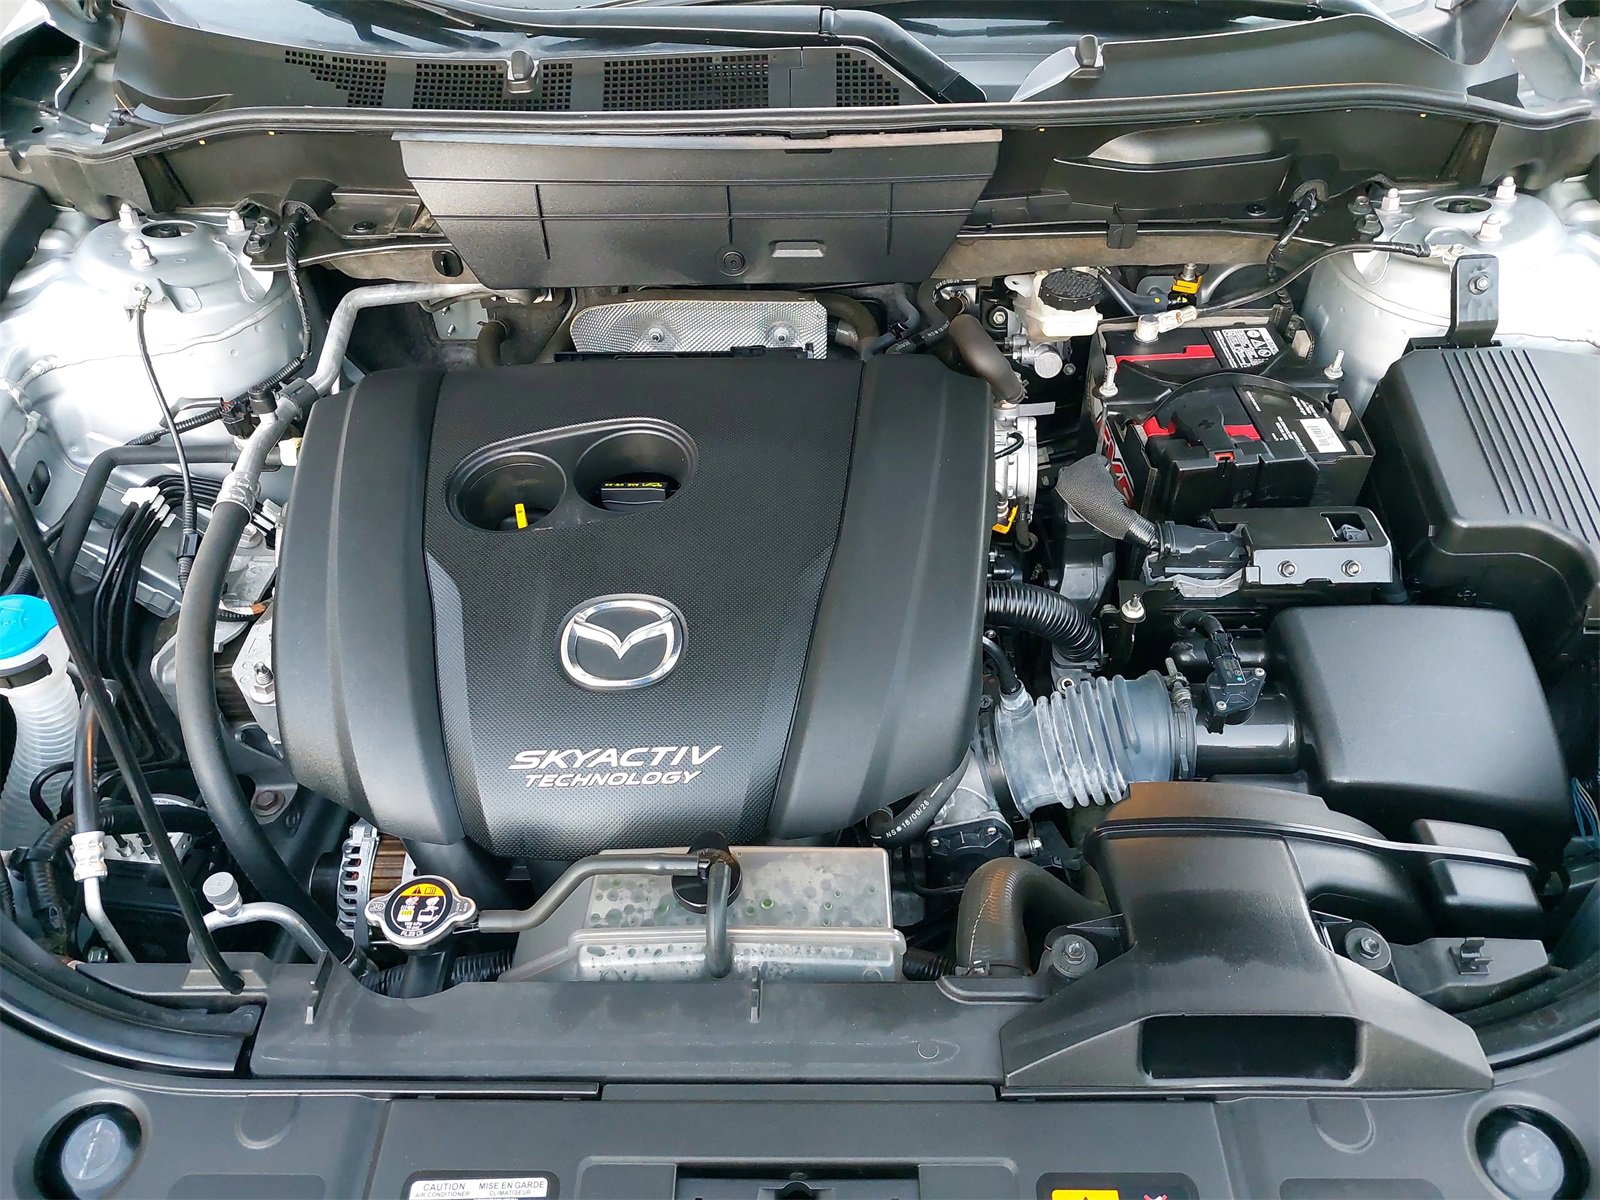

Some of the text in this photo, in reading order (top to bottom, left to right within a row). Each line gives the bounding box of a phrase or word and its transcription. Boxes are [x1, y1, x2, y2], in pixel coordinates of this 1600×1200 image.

[508, 745, 722, 769] SKYACTIV
[525, 771, 702, 788] TECHNOLOGY
[423, 1182, 466, 1192] CAUTION
[478, 1182, 499, 1190] MISE
[514, 1181, 544, 1189] GARDE
[489, 1189, 531, 1197] CLIMATISEUR
